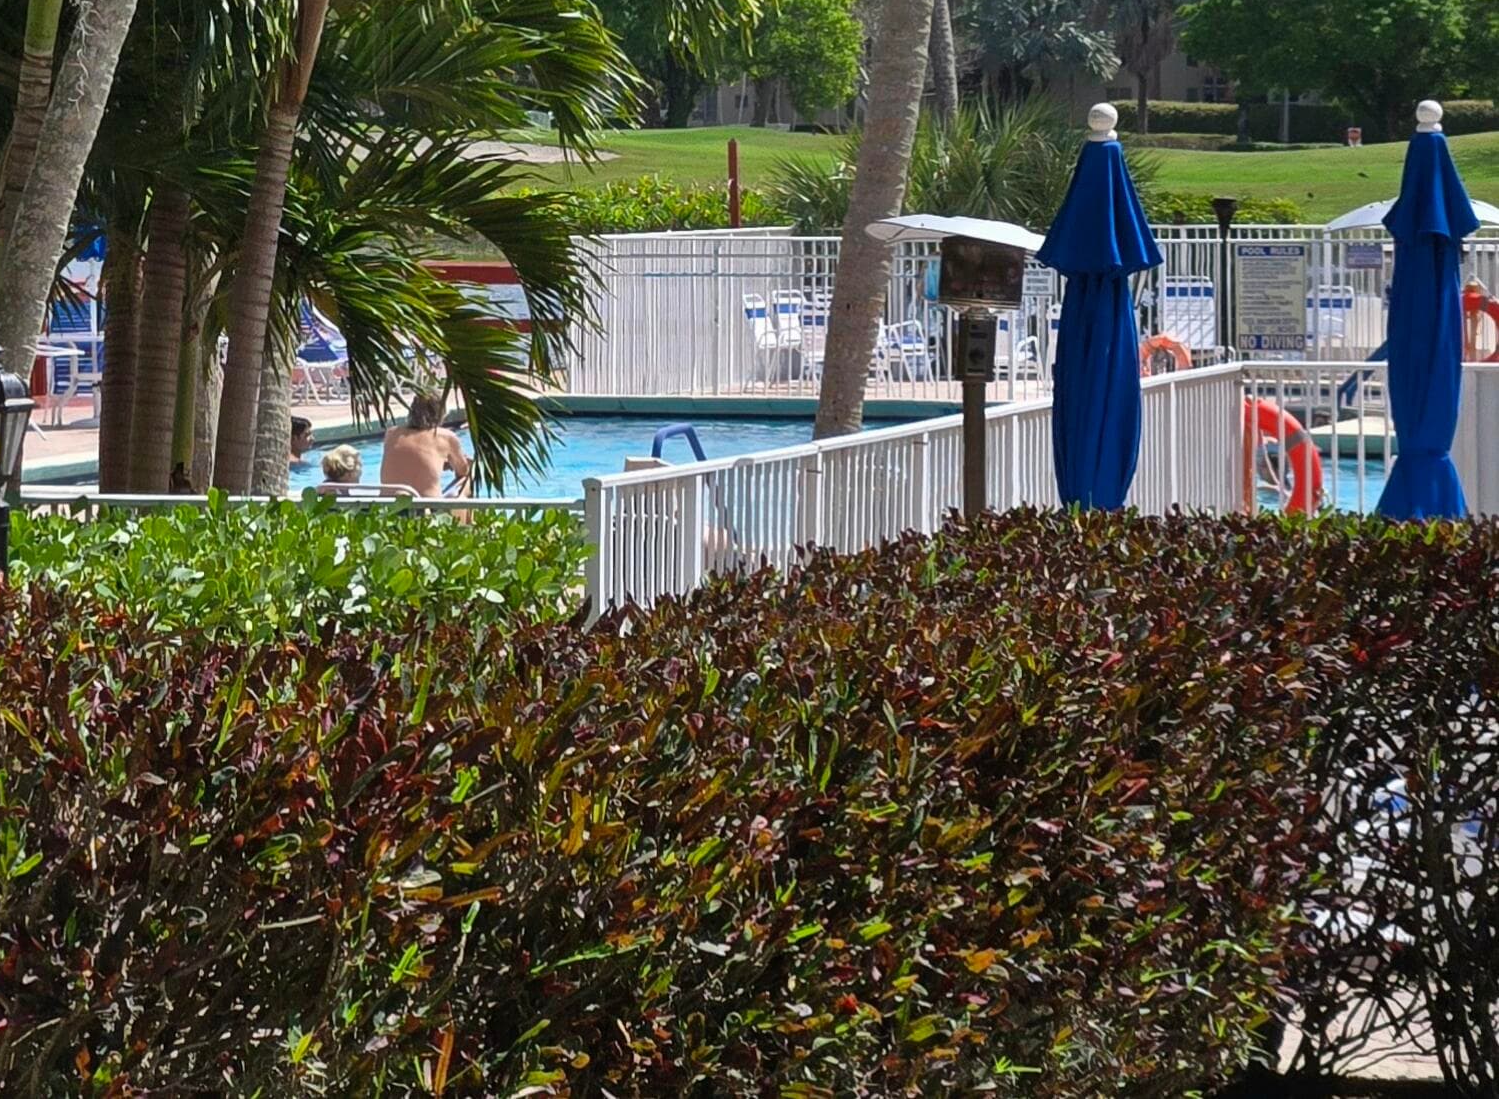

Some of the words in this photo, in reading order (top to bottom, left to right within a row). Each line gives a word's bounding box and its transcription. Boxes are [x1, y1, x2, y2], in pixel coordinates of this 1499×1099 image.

[1241, 246, 1266, 255] POOL
[1270, 246, 1301, 255] RULES
[1240, 335, 1257, 349] NO
[1261, 335, 1304, 350] DIVING
